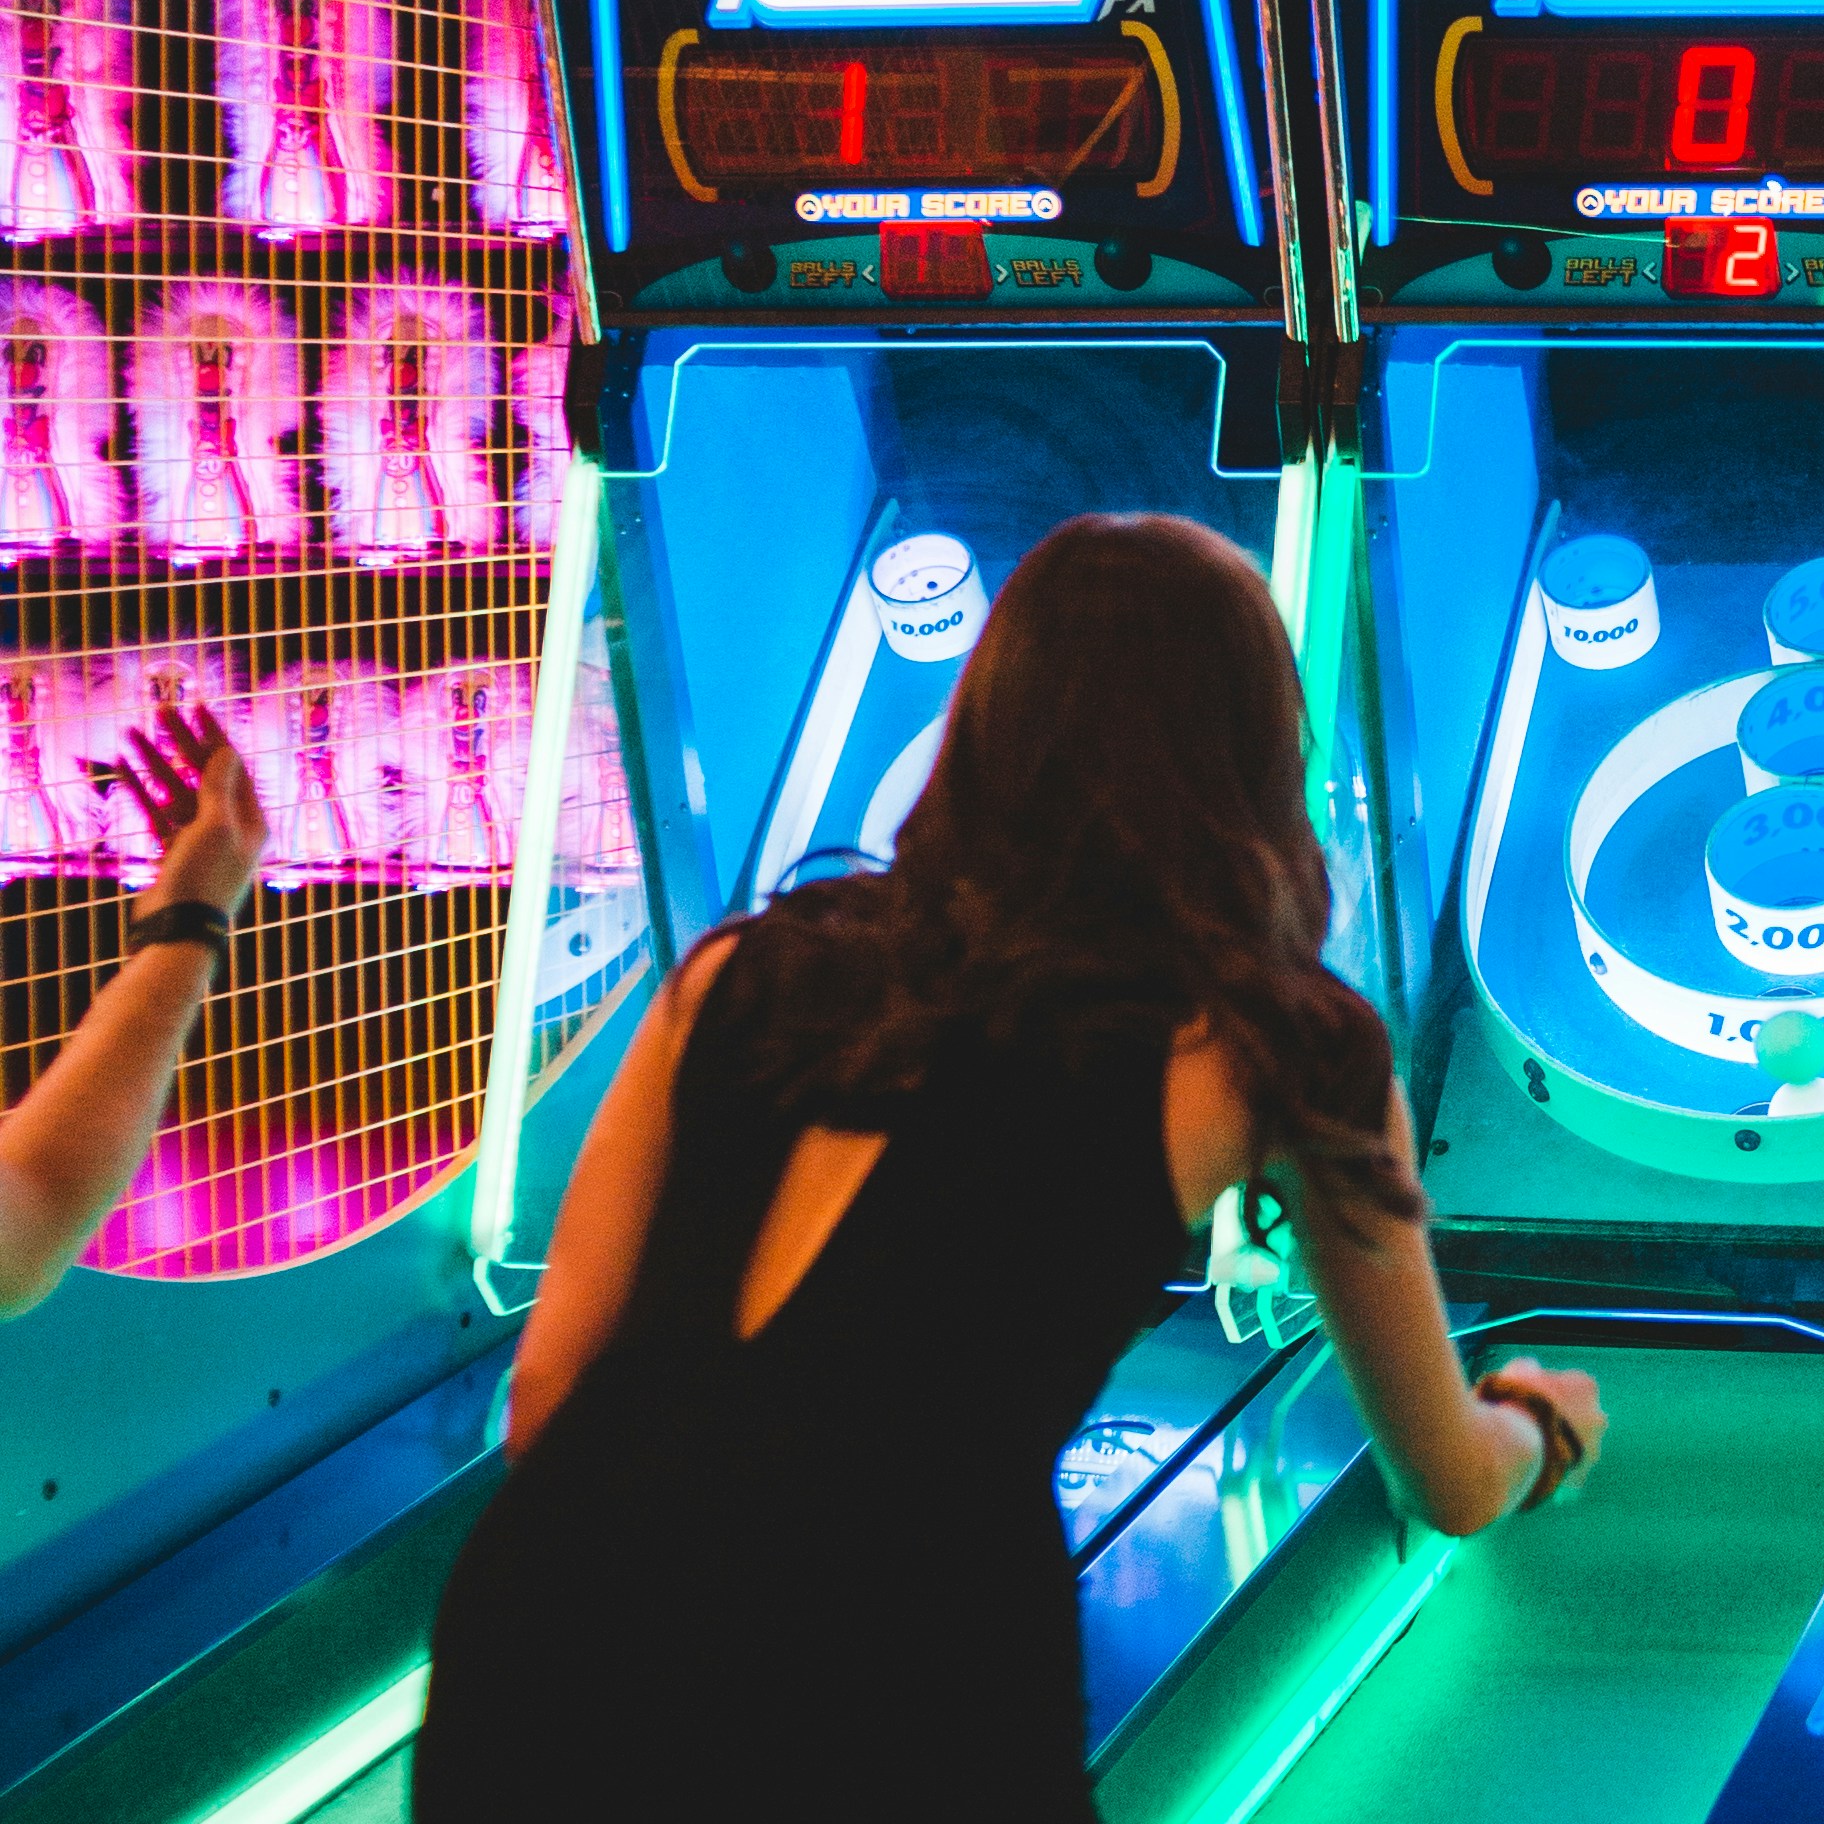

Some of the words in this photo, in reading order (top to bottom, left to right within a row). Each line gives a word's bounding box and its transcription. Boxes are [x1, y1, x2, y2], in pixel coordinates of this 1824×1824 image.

[820, 192, 910, 218] YOUR
[921, 192, 1033, 218] SCORE
[1604, 188, 1697, 215] YOUR
[1566, 257, 1635, 271] BALLS
[1726, 226, 1768, 286] 2
[790, 262, 855, 273] BALLS
[1012, 259, 1080, 272] BALLS
[790, 272, 855, 287] LEFT
[1014, 271, 1083, 285] LEFT
[1564, 269, 1637, 285] LEFT
[891, 610, 964, 637] 10,000
[1563, 618, 1640, 646] 10,000
